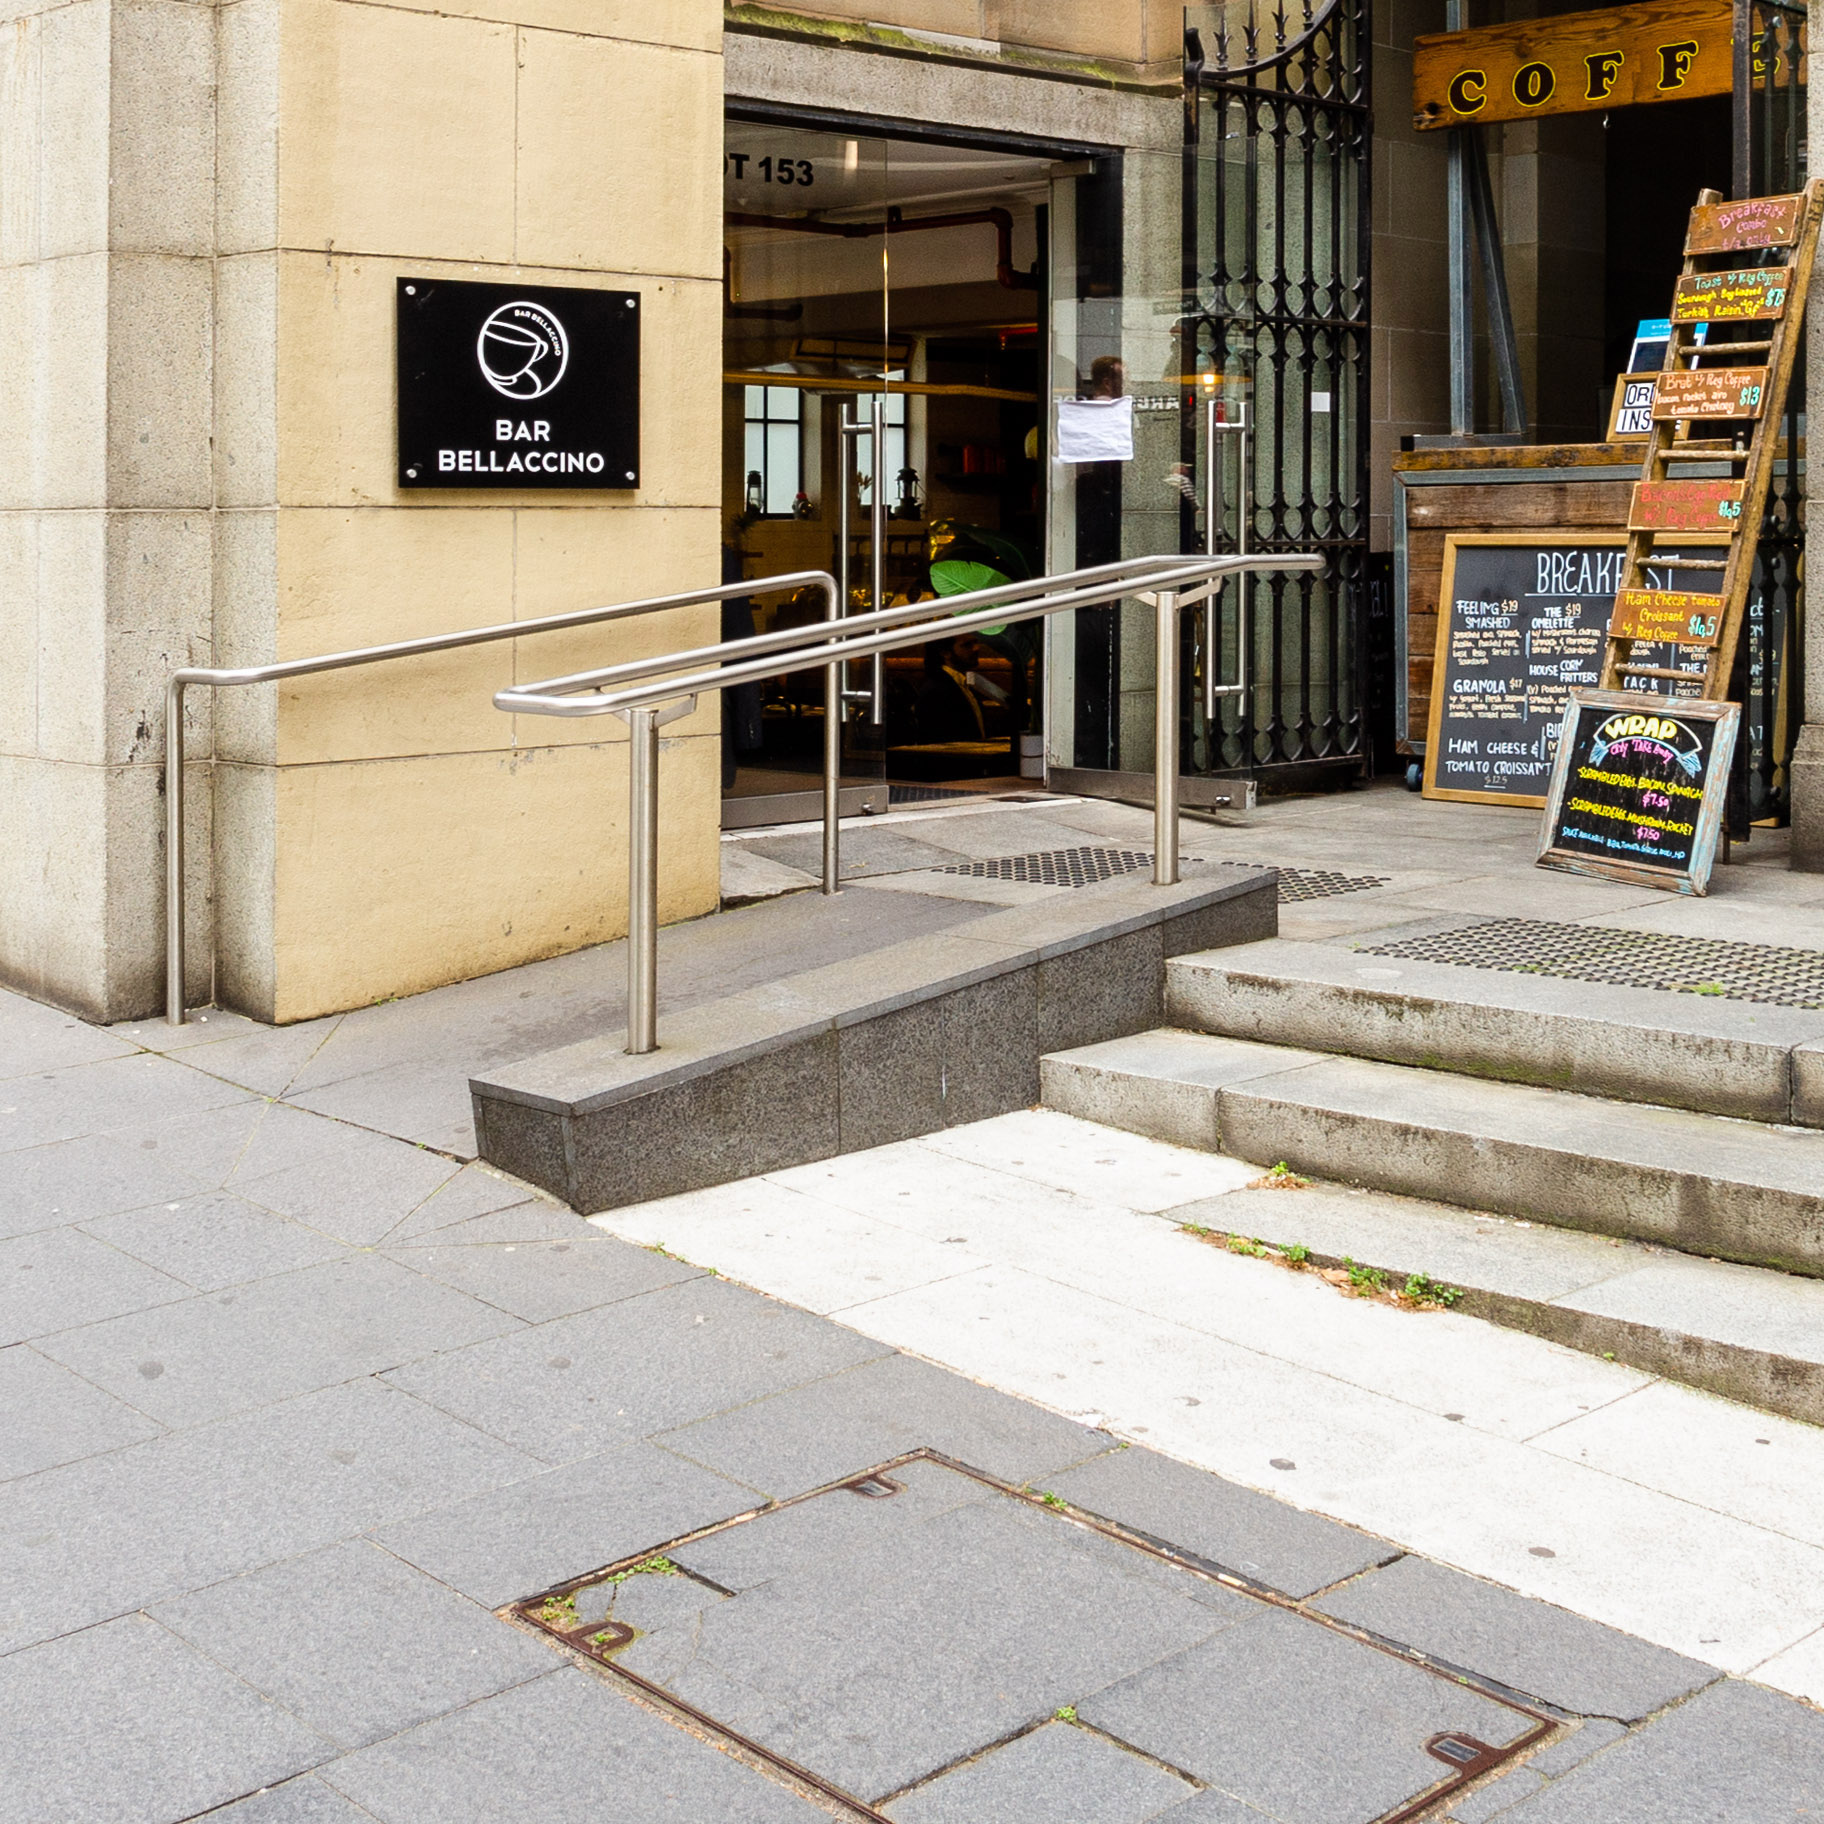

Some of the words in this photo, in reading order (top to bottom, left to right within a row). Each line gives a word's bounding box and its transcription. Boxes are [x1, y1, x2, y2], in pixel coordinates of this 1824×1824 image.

[723, 152, 750, 180] T
[758, 156, 814, 186] 153
[1718, 202, 1786, 229] Breakfast
[1695, 276, 1722, 290] Toast
[514, 309, 531, 318] BAR
[531, 313, 562, 356] BELLACCINO
[1706, 373, 1723, 389] Reg
[1724, 372, 1751, 388] Coffee
[1627, 384, 1656, 406] OR
[1739, 386, 1761, 406] $13
[496, 419, 550, 441] BAR
[438, 450, 605, 473] BELLACCINO
[1456, 600, 1500, 615] FEELING
[1501, 599, 1518, 613] $19
[1625, 592, 1651, 606] Ham
[1655, 592, 1687, 606] Cheese
[1543, 606, 1562, 617] THE
[1565, 602, 1582, 617] $19
[1640, 608, 1685, 622] Croissant
[1465, 616, 1511, 629] SMASHED
[1531, 617, 1575, 629] OMELETTE
[1529, 664, 1558, 676] HOUSE
[1560, 672, 1599, 683] FRITTERS
[1453, 679, 1506, 694] GRANOLA
[1605, 715, 1677, 740] WRAP
[1448, 738, 1479, 754] HAM
[1487, 742, 1527, 755] CHEESE
[1445, 760, 1490, 774] TOMATO
[1494, 762, 1552, 776] CROISSANT
[1642, 790, 1669, 808] $7.50
